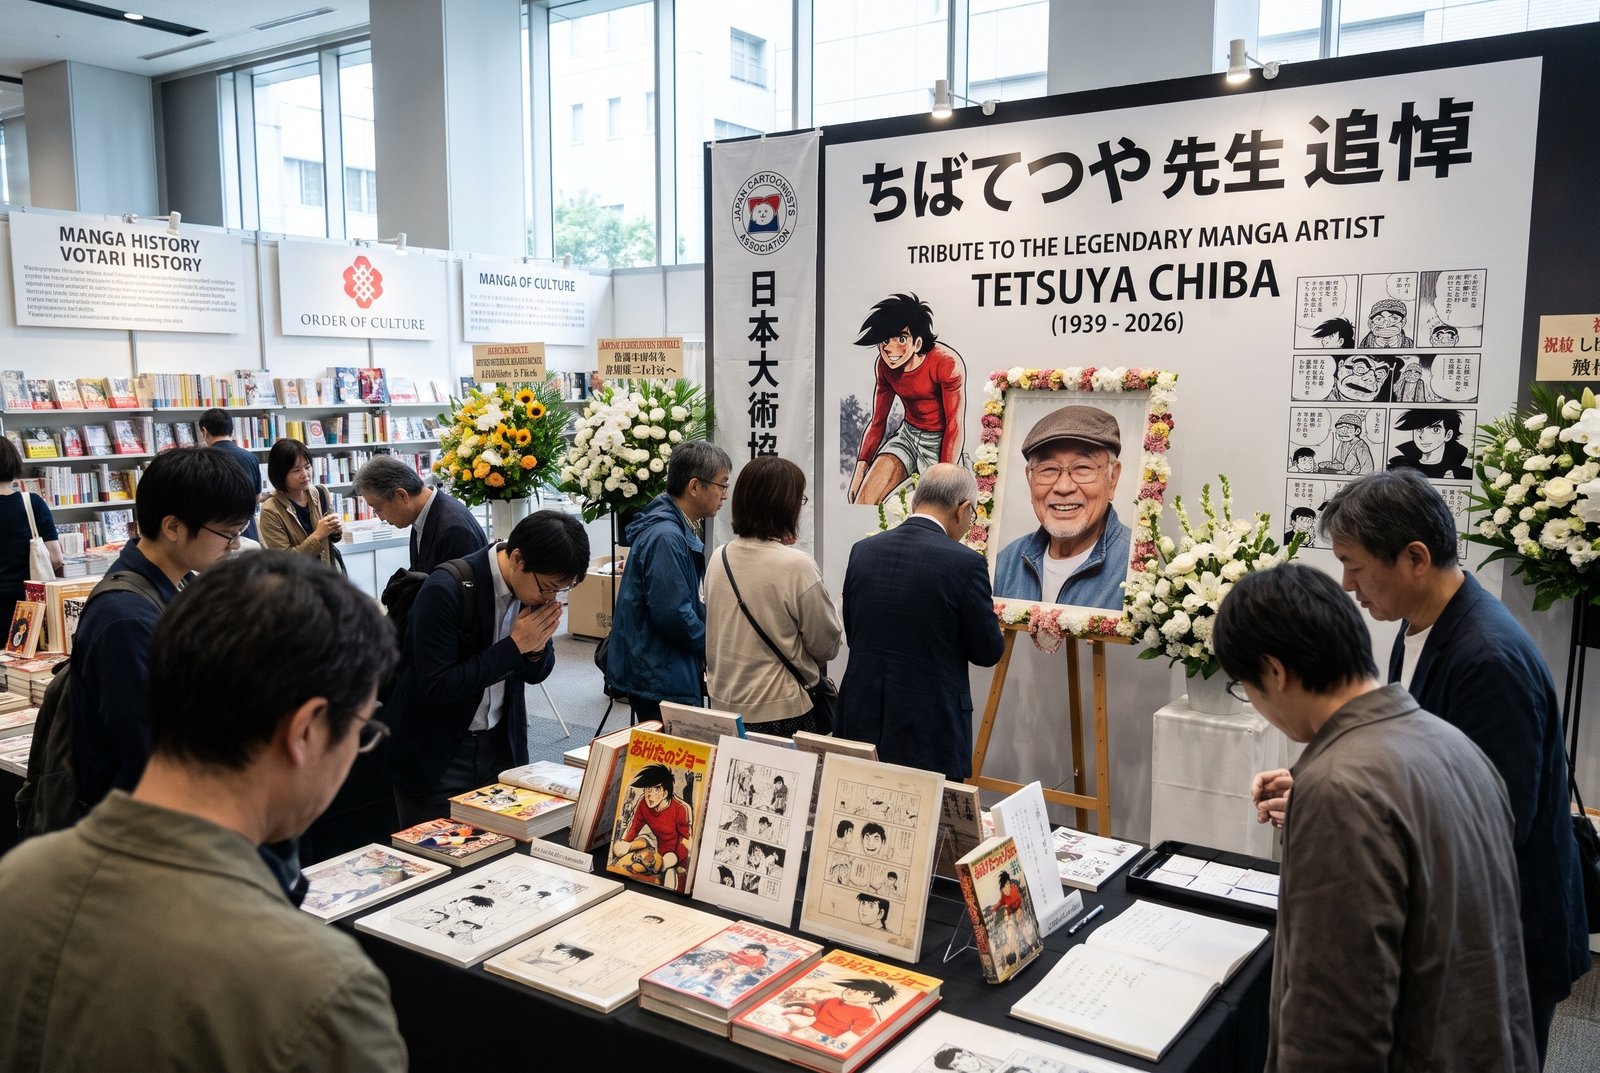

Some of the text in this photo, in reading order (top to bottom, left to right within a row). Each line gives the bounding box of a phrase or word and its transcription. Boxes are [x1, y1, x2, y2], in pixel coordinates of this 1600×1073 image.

[862, 97, 1474, 223] ちばてつや 先生 追悼
[734, 189, 748, 222] JAPAN
[59, 226, 200, 254] MANGA HISTORY
[740, 229, 790, 252] ASSOCIATION
[907, 214, 1385, 264] TRIBUTE TO THE LEGENDARY MANGA ARTIST
[60, 246, 202, 272] VOTARI HISTORY
[479, 272, 576, 292] MANGA OF CULTURE
[971, 265, 1138, 308] TETSUYA
[1148, 259, 1281, 302] CHIBA
[300, 313, 425, 331] ORDER OF CULTURE
[1051, 314, 1107, 337] (1939
[1124, 310, 1184, 335] 2026)
